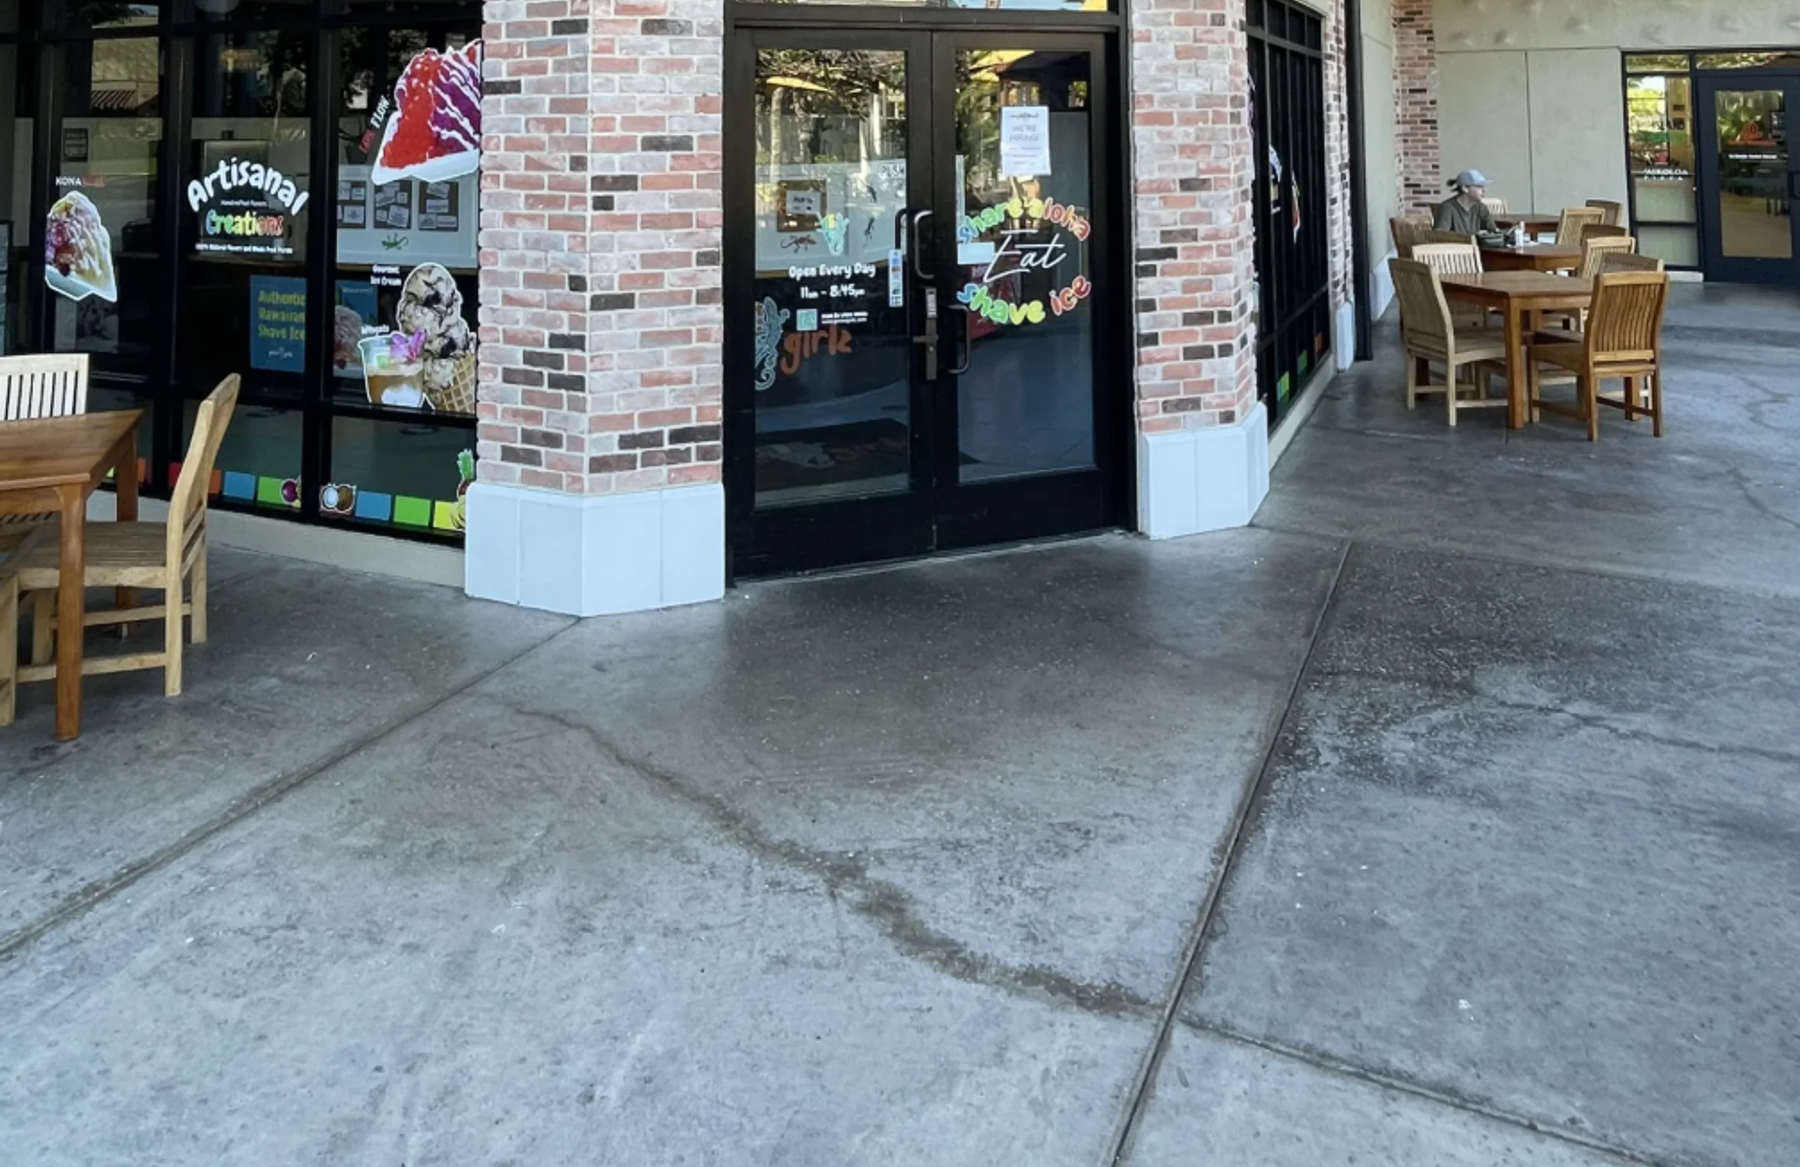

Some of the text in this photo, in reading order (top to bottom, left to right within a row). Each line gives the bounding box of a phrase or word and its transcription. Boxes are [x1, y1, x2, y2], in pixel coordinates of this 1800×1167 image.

[370, 94, 390, 129] FLOW
[55, 175, 82, 187] KONA
[187, 156, 309, 216] Artisanal
[205, 209, 284, 237] Creations
[983, 229, 1068, 283] Eat
[788, 262, 876, 281] Open Every Day
[258, 290, 306, 306] Authentic
[1048, 275, 1092, 316] ice
[258, 306, 306, 323] Hawaiian
[258, 324, 306, 341] Shave Ice
[780, 323, 852, 375] girlz
